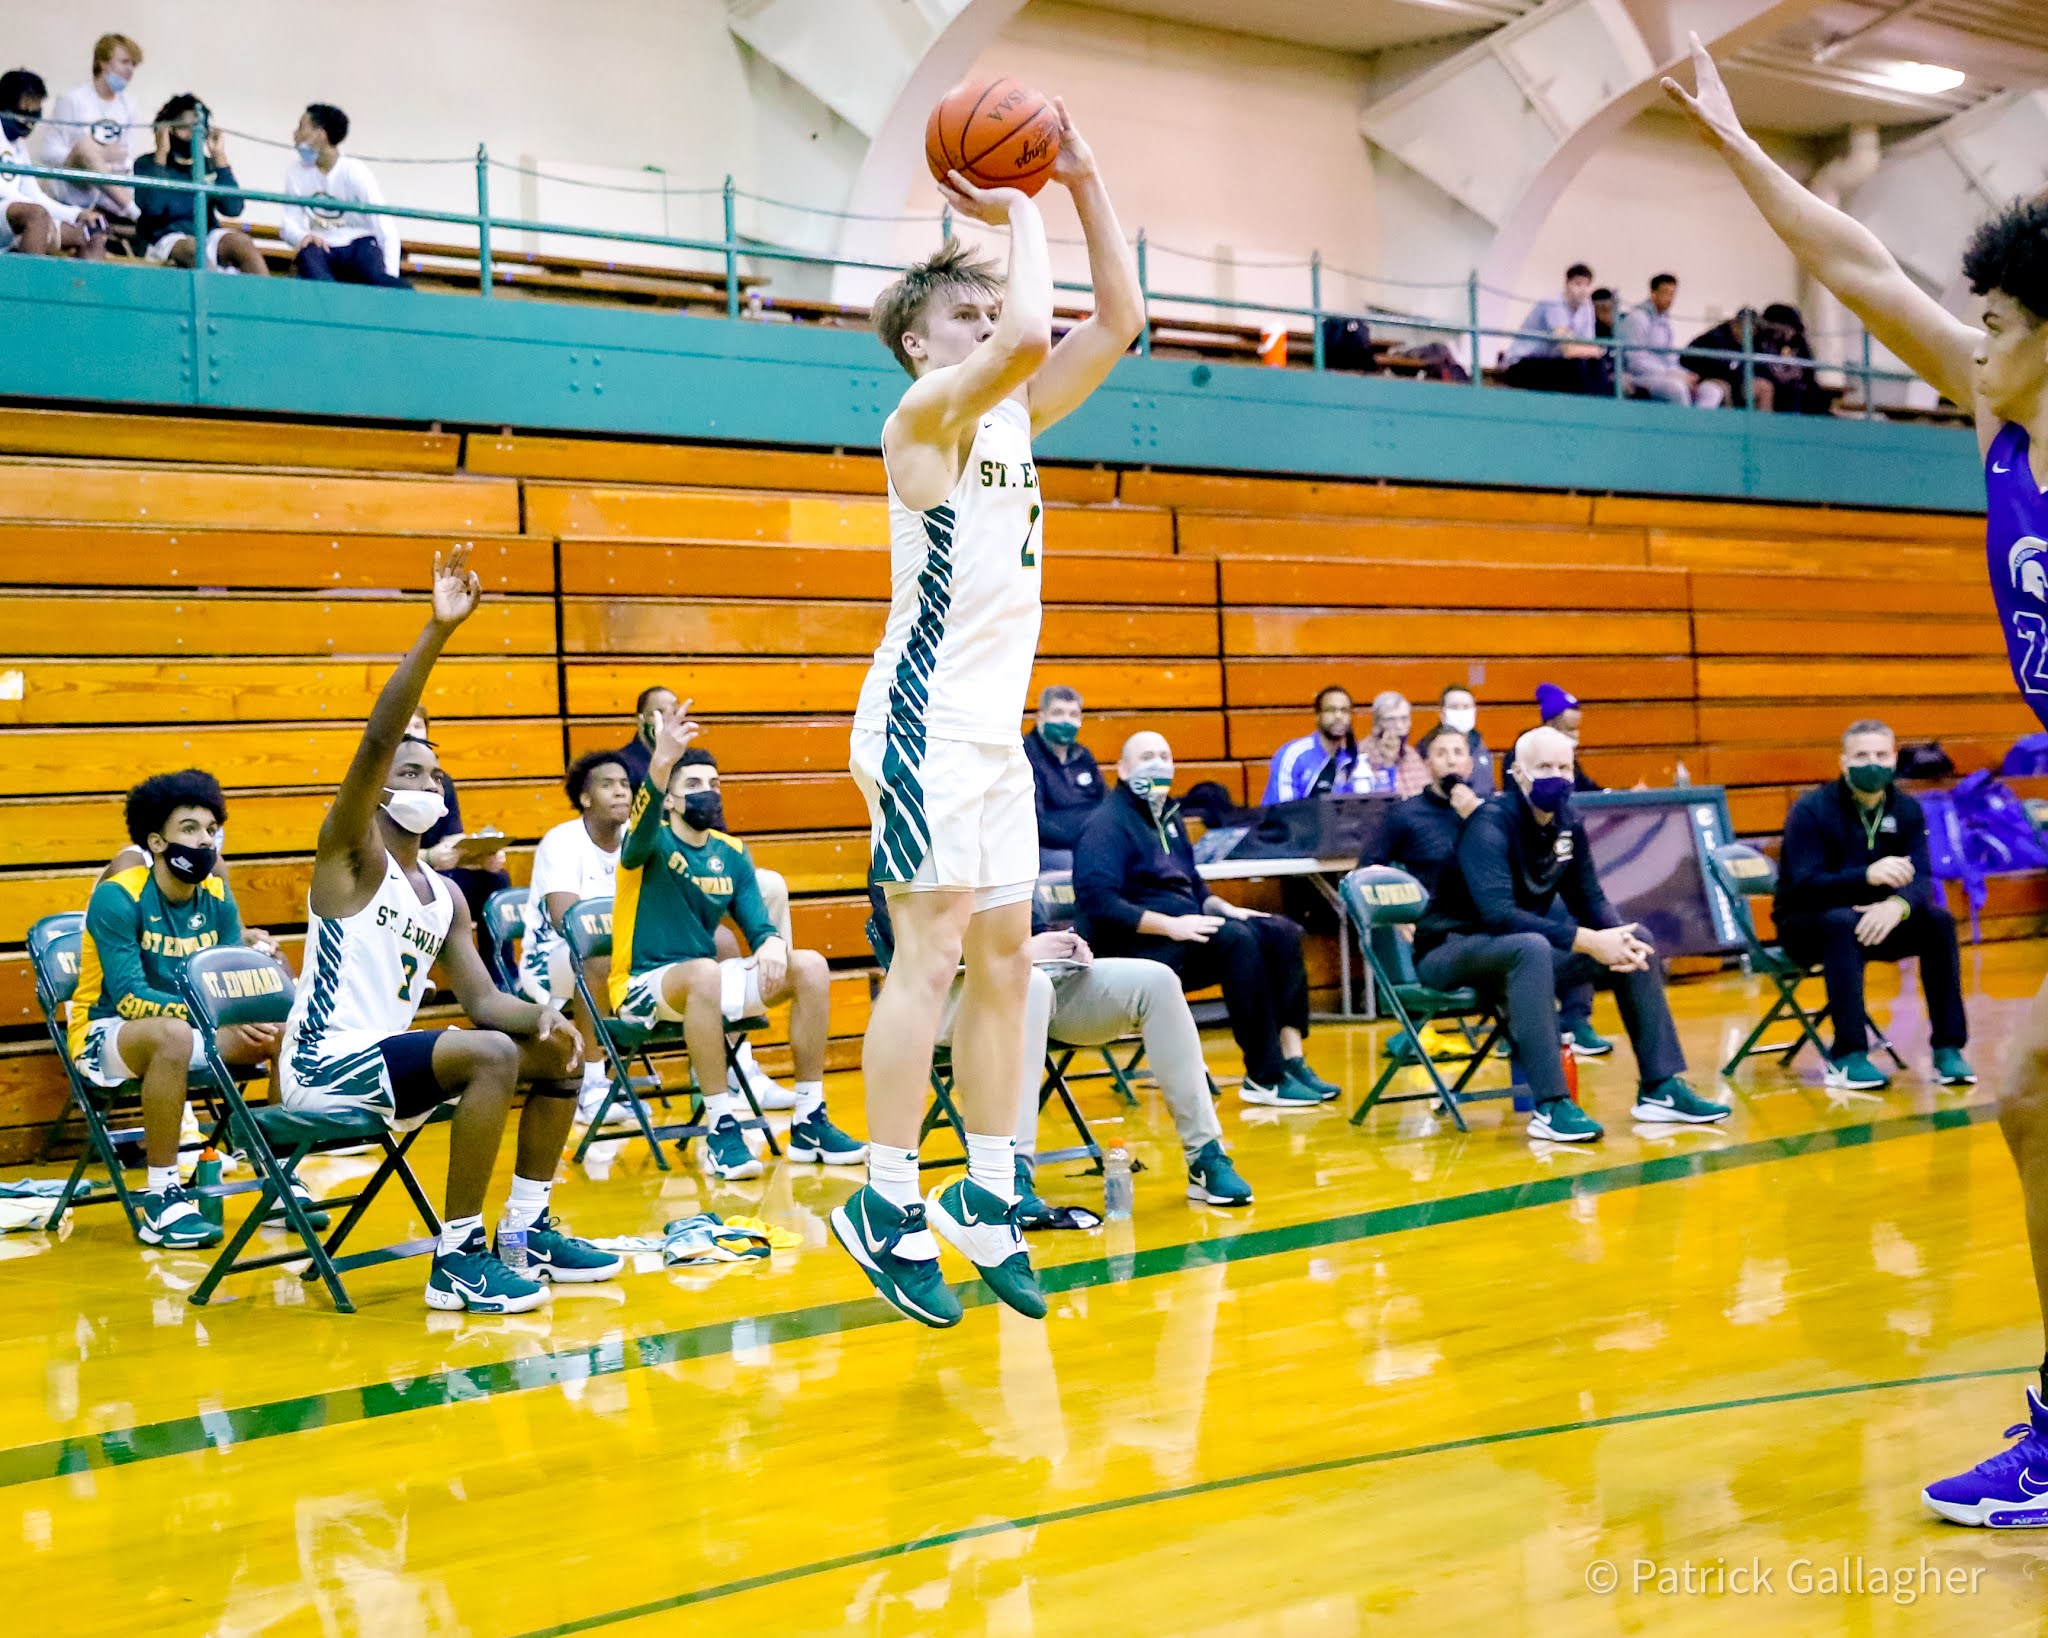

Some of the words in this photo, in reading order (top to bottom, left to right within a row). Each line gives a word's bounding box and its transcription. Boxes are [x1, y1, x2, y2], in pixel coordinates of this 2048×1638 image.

[980, 460, 1016, 488] ST.
[201, 970, 227, 999] ST.
[221, 966, 284, 999] EDWARD
